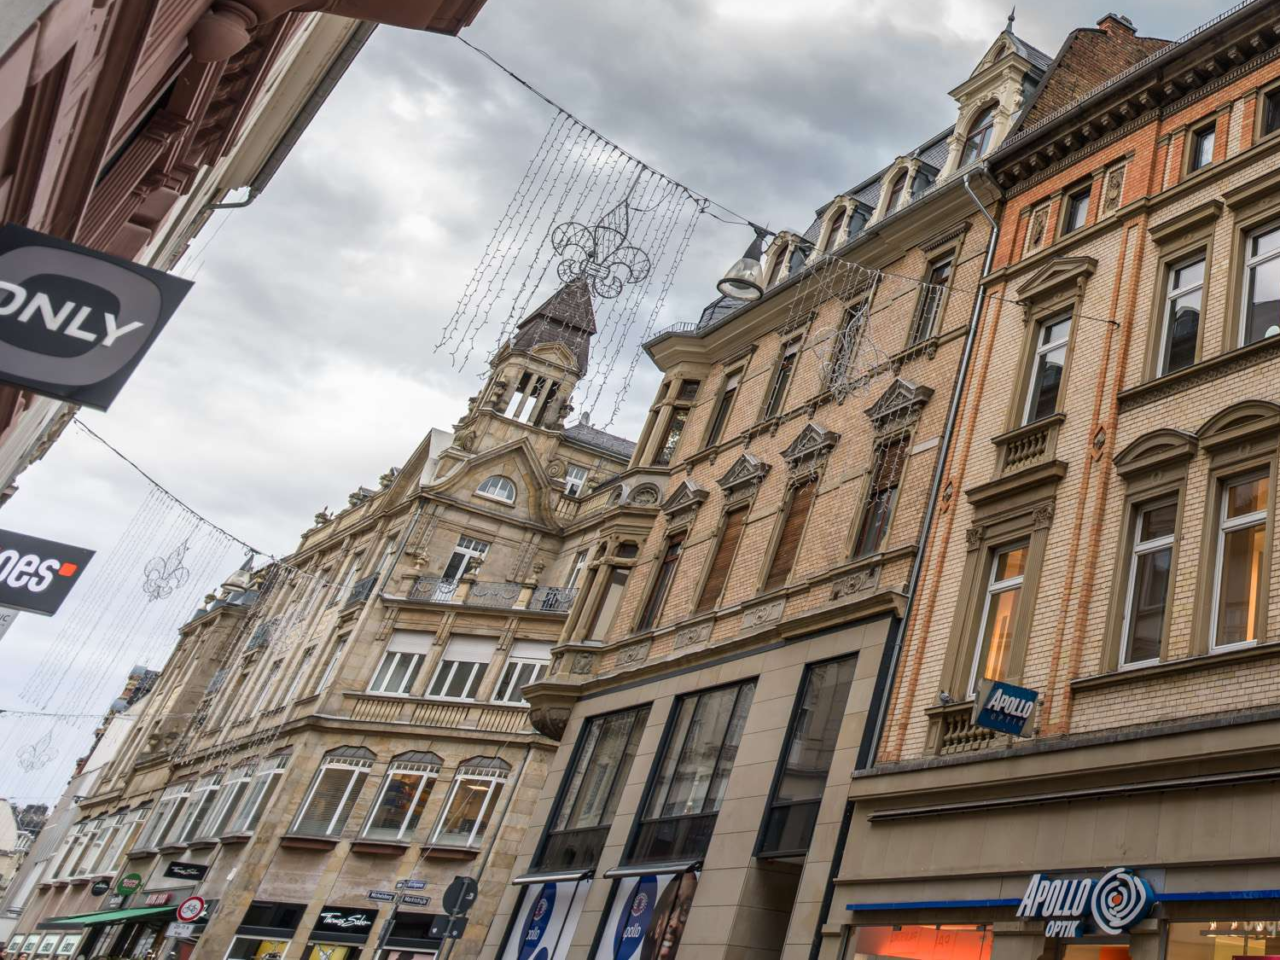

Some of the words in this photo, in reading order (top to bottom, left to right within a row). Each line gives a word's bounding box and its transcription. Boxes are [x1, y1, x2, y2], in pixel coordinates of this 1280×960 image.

[986, 688, 1034, 718] APOLLO
[1016, 873, 1093, 918] APOLLO
[1045, 920, 1081, 938] OPTIK
